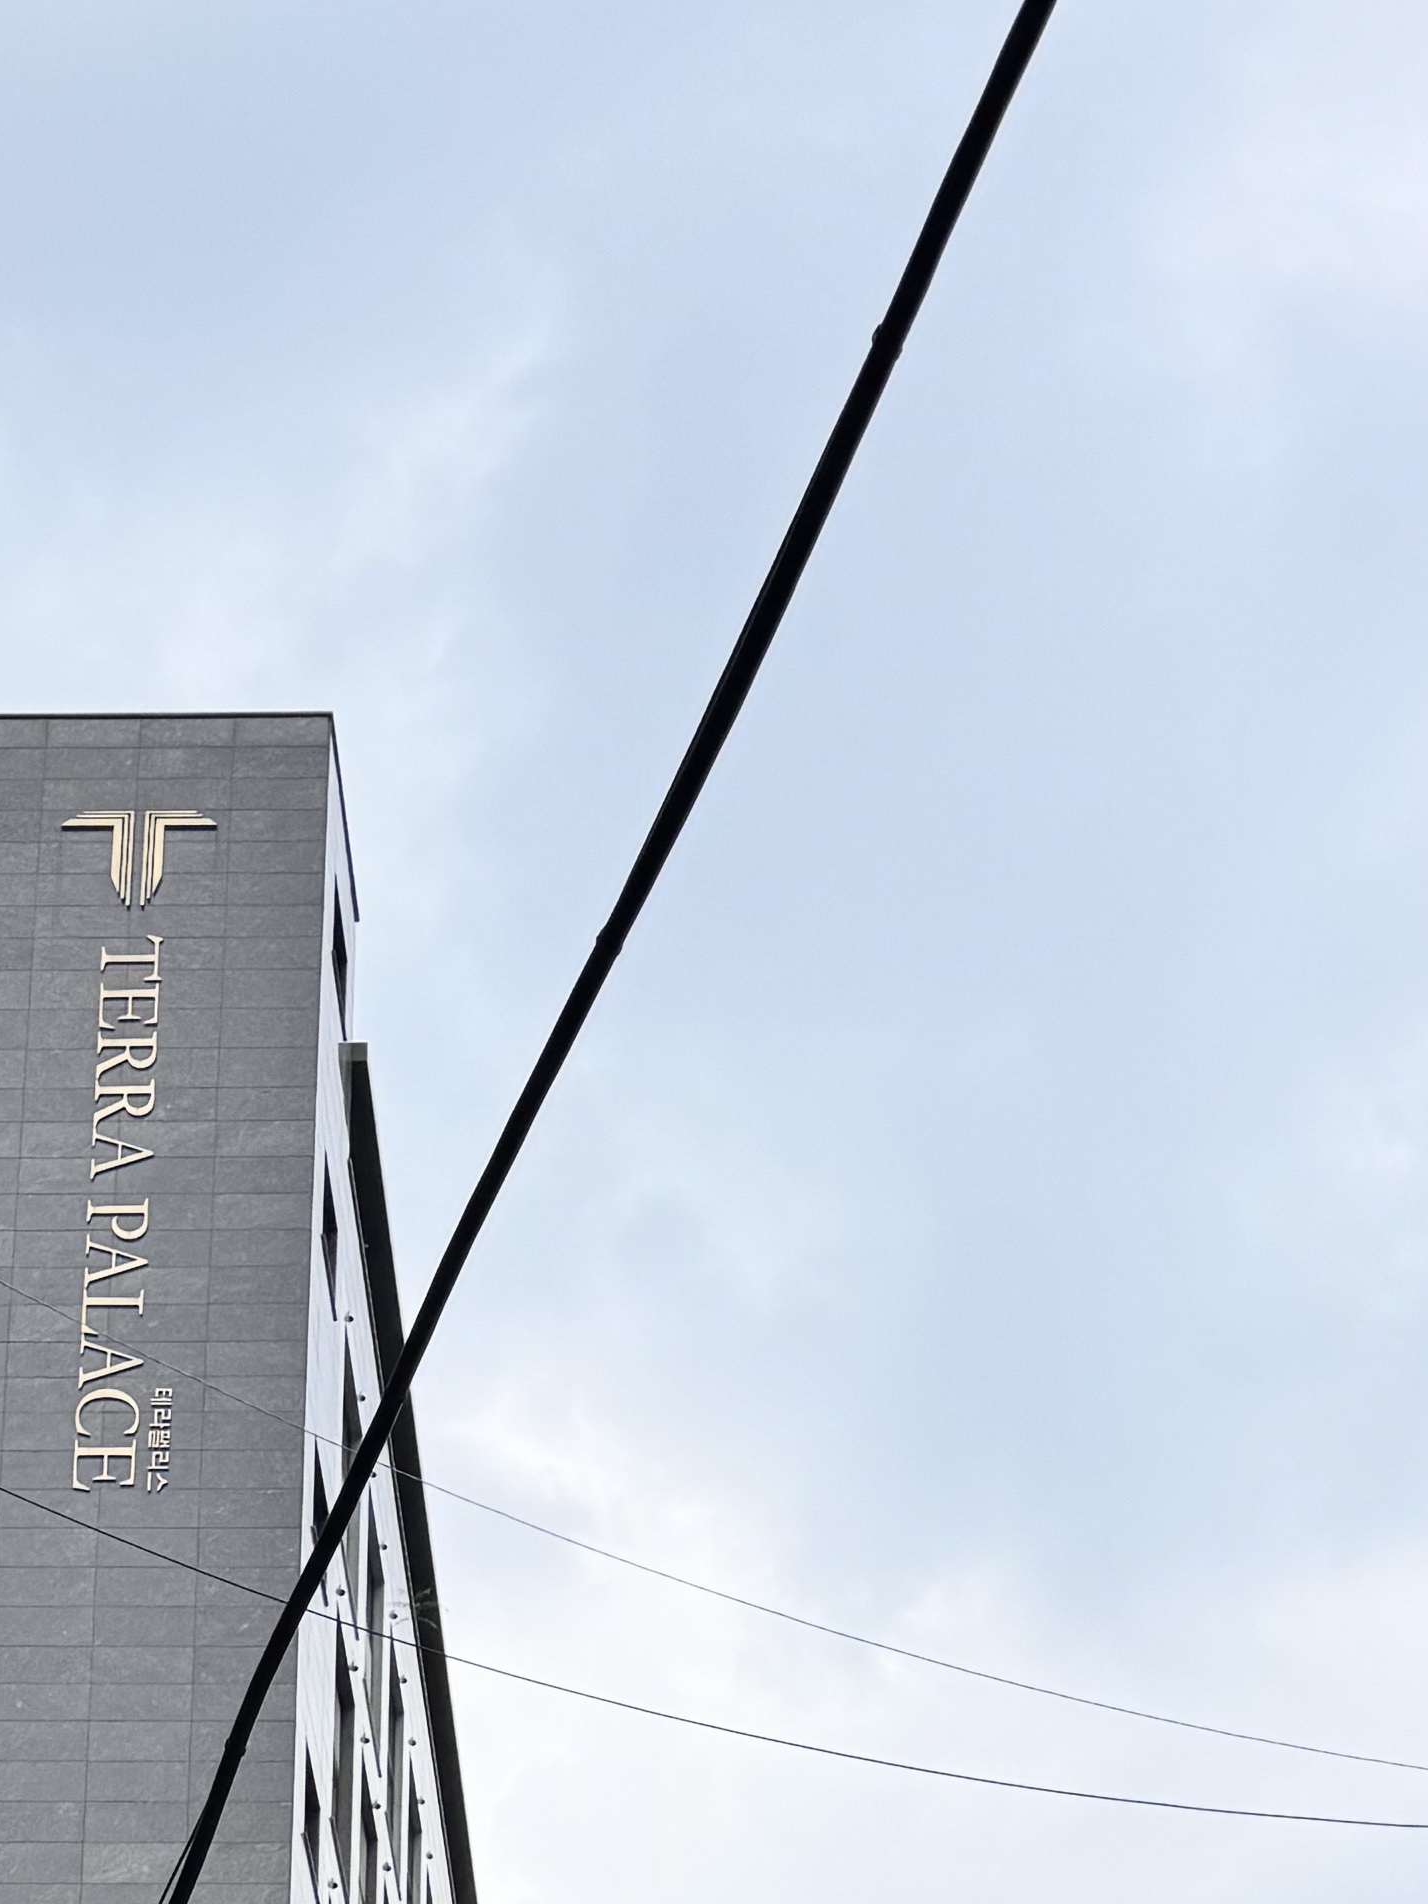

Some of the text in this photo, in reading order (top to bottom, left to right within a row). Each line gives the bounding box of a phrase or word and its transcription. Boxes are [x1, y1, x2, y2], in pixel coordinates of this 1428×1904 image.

[72, 934, 162, 1491] TERRA PALACE
[146, 1388, 172, 1493] 테라팰리스
